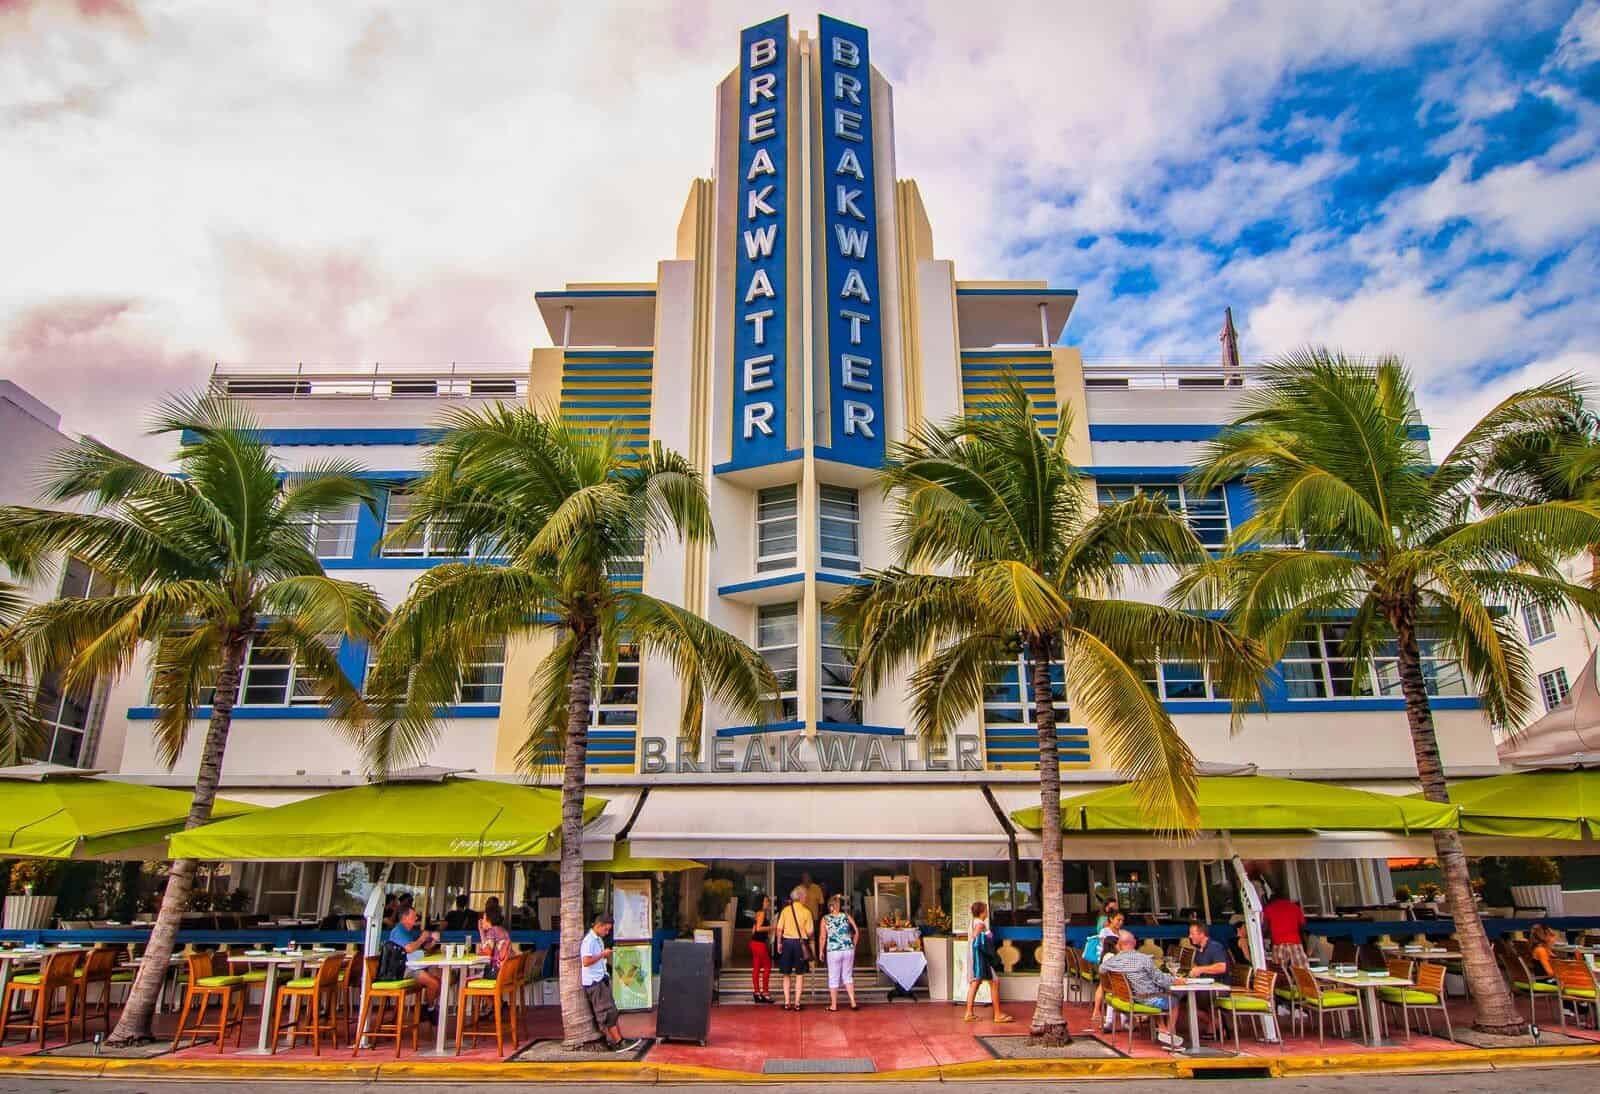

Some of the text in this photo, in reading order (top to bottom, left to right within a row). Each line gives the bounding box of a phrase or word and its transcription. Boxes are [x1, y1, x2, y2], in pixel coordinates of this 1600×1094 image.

[744, 37, 777, 440] BREAKWATER
[832, 36, 876, 439] BREAKWATER
[640, 735, 984, 773] BREAKWATER
